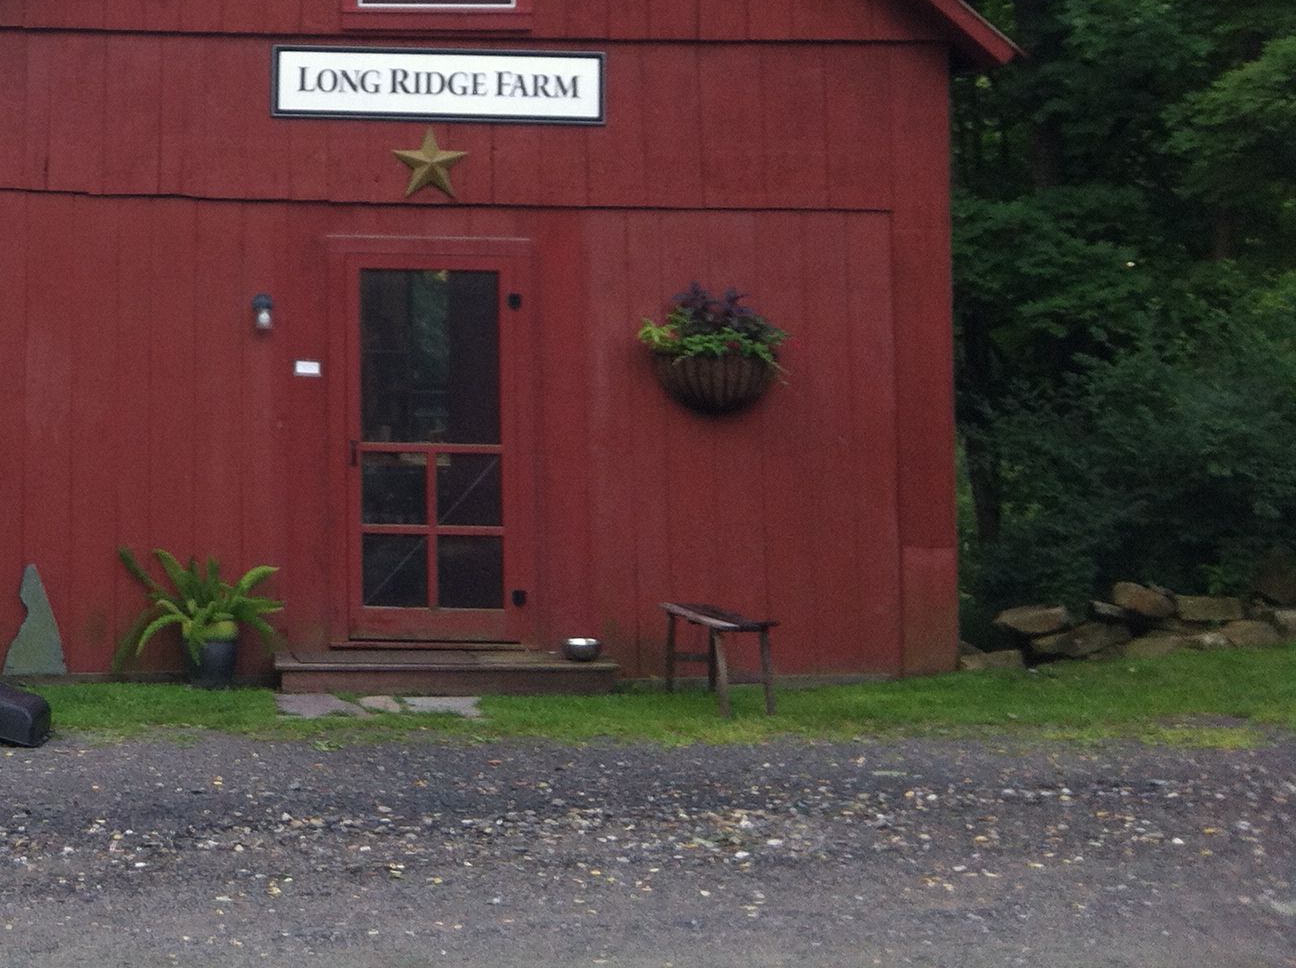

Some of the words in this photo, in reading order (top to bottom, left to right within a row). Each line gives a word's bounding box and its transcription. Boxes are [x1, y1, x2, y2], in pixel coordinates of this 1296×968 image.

[298, 66, 381, 94] LONG
[389, 68, 487, 97] RIDGE
[495, 70, 581, 99] FARM
